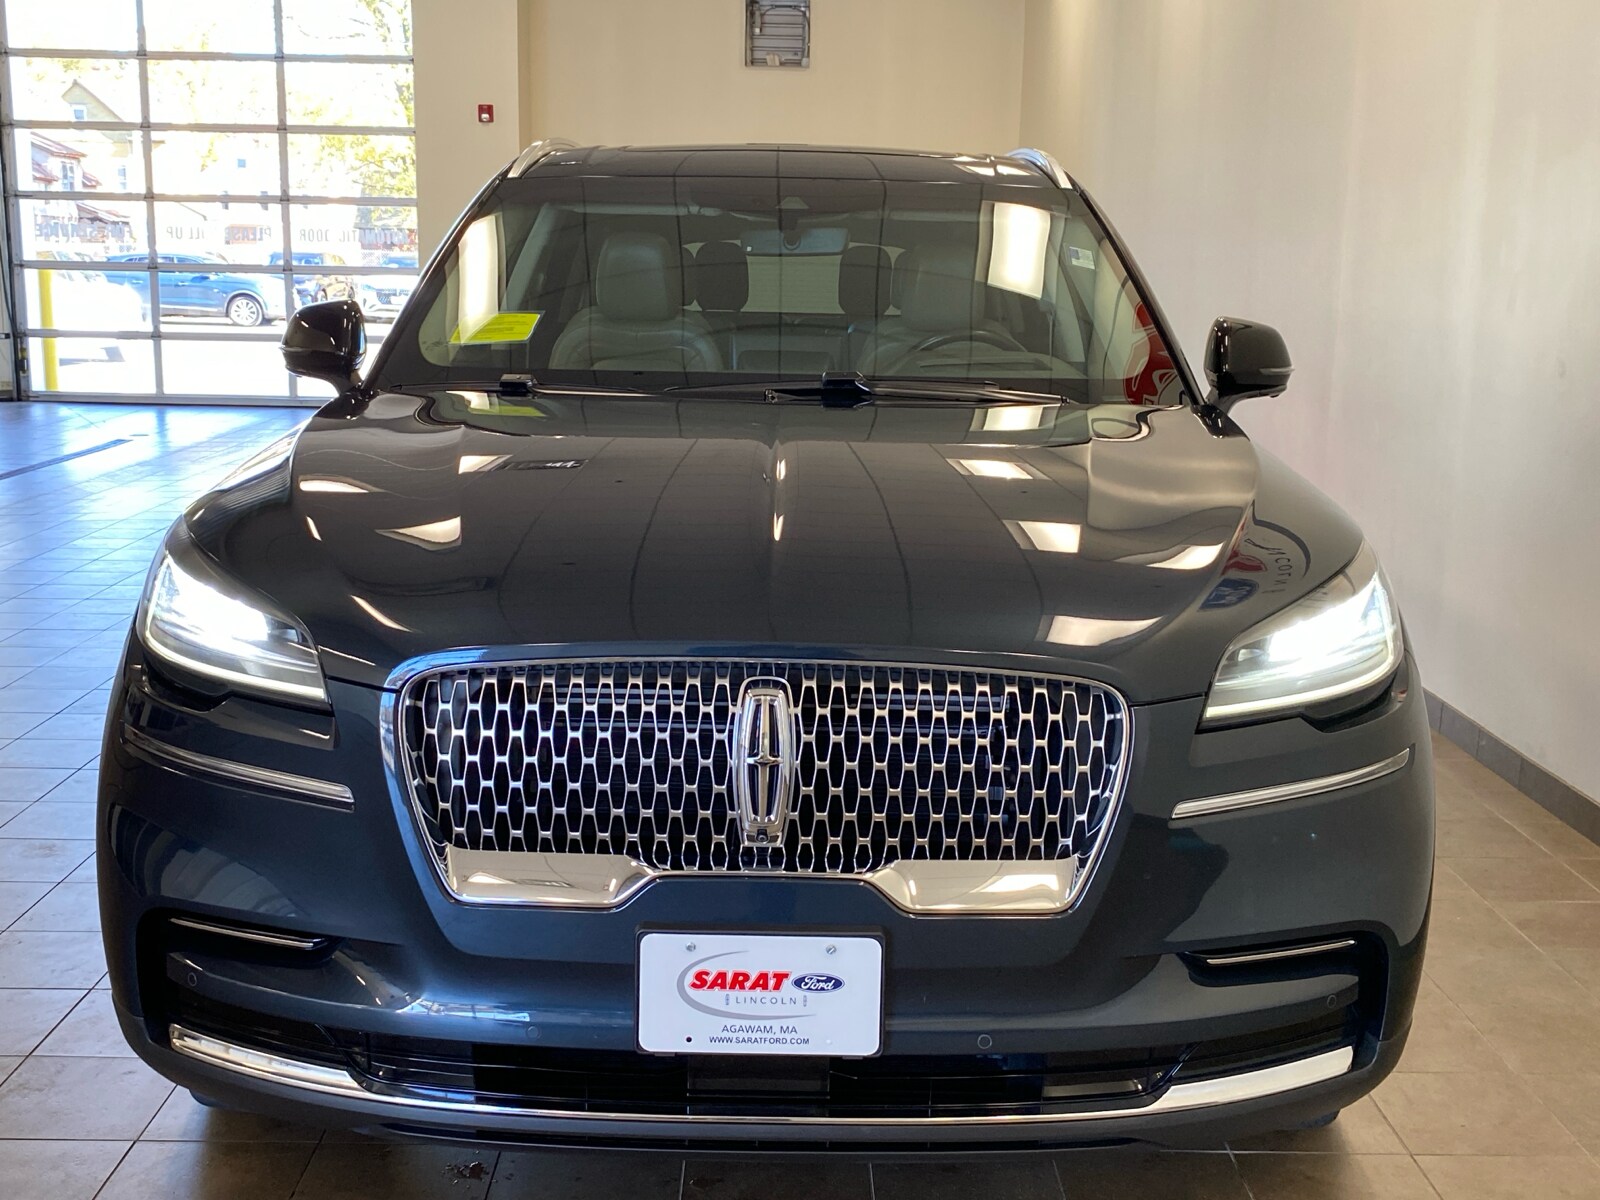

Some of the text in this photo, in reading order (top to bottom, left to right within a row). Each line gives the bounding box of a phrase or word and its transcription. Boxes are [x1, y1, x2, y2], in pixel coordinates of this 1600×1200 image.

[690, 969, 835, 991] SARAT Ford
[735, 996, 797, 1005] LINCOLN
[721, 1024, 798, 1035] AGAWAM, MA
[709, 1036, 810, 1045] WWW.SARATFORD.COM
